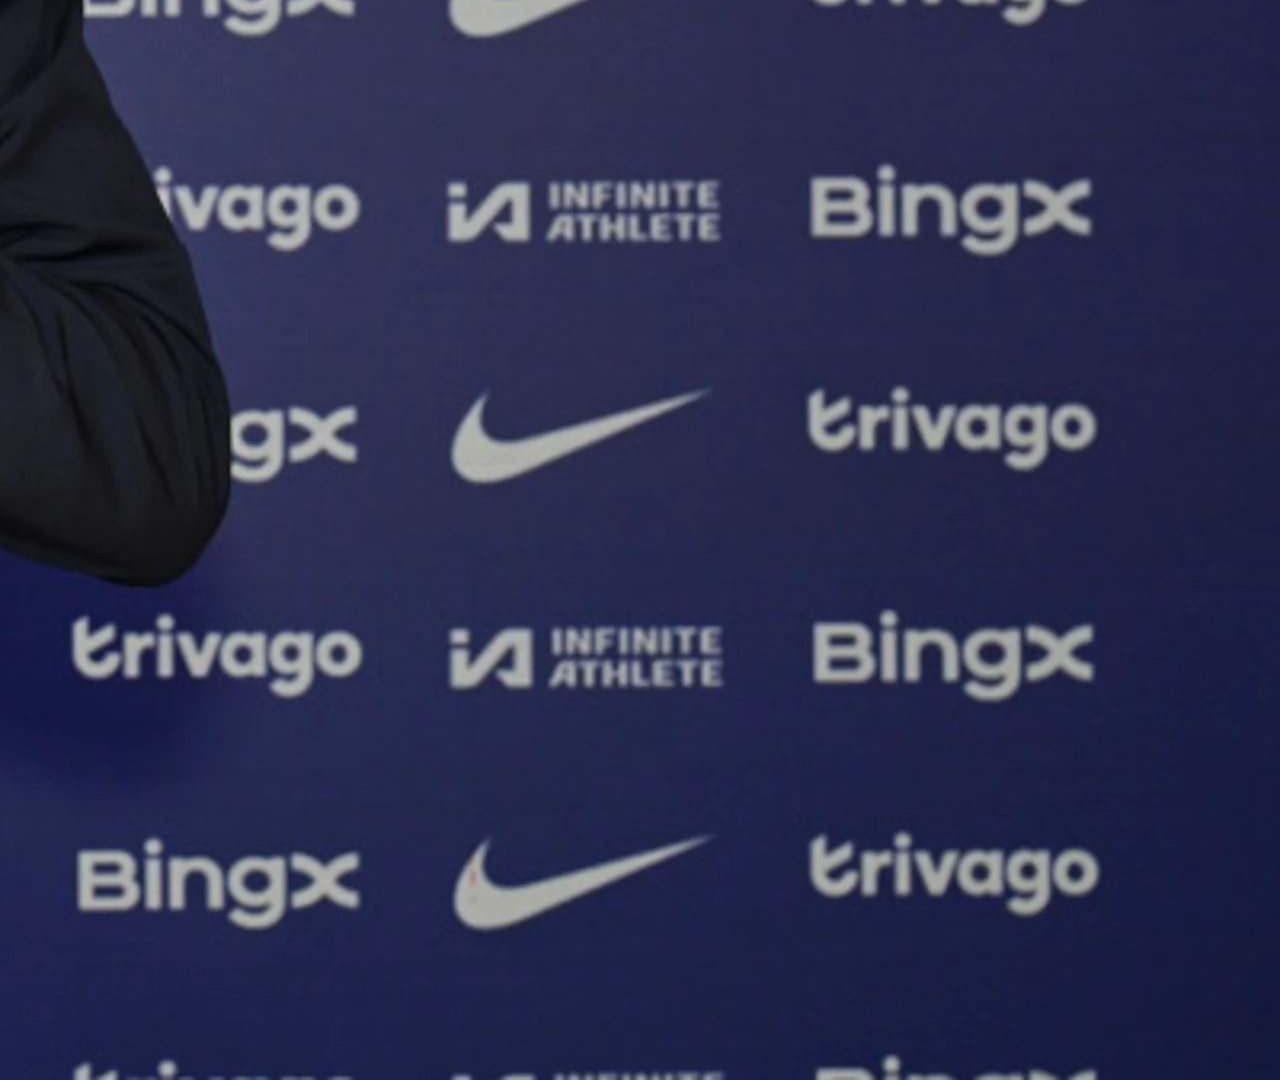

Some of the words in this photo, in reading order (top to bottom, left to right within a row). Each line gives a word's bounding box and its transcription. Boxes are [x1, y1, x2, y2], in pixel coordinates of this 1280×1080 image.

[154, 166, 359, 251] ivago
[549, 181, 716, 209] INFINITE
[547, 213, 718, 241] ATHLETE
[808, 387, 1096, 470] trivago
[73, 615, 362, 697] trivago
[552, 627, 719, 655] INFINITE
[549, 660, 720, 687] ATHLETE
[810, 833, 1099, 915] trivago
